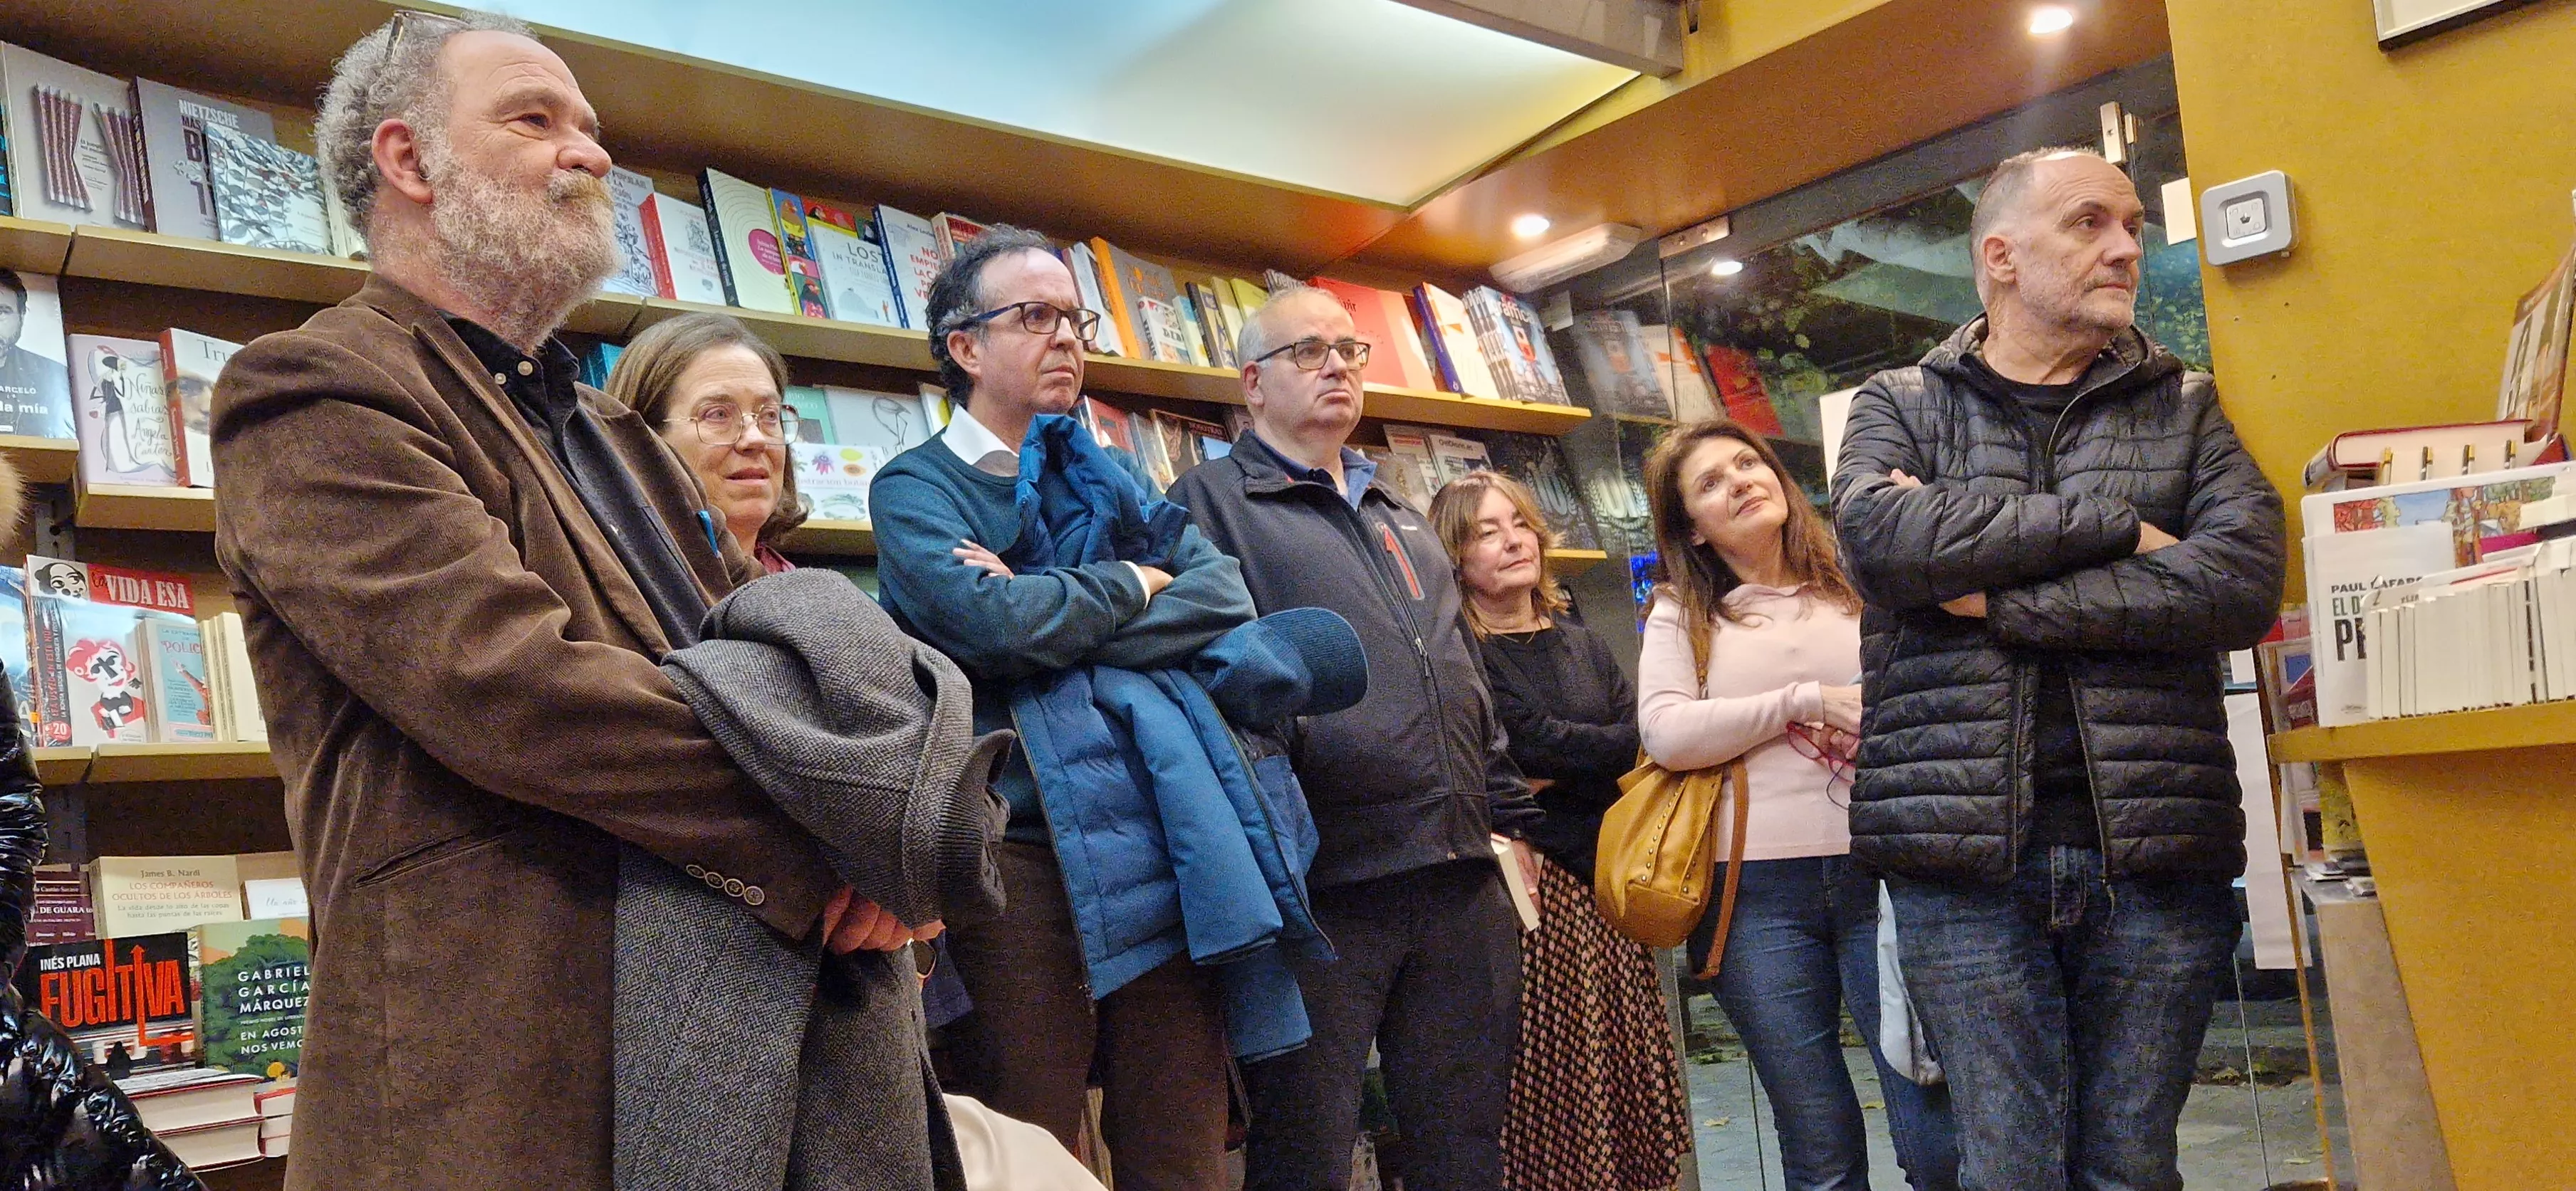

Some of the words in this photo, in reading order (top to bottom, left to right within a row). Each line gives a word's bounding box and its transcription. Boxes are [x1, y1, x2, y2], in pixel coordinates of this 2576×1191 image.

[178, 99, 240, 129] NIETZSCHE
[921, 246, 939, 261] NO
[846, 256, 888, 274] TRANSLA
[197, 339, 226, 362] Tru
[0, 385, 37, 394] ARCELO
[127, 373, 165, 400] Niñas
[19, 403, 48, 414] mía
[105, 574, 153, 604] VIDA
[155, 580, 189, 609] ESA
[2331, 582, 2367, 594] PAUL
[2332, 597, 2349, 617] EL
[160, 641, 202, 655] POLIC
[53, 723, 67, 735] 20
[150, 880, 214, 889] COMPAÑEROS
[112, 892, 157, 901] OCULTOS
[174, 891, 192, 900] LOS
[194, 890, 233, 899] ÁRBOLES
[40, 955, 65, 971] INÉS
[66, 953, 101, 967] PLANA
[238, 965, 311, 982] GABRIEL
[40, 951, 186, 1030] FUGITIVA
[238, 979, 310, 997] GARCÍA
[239, 996, 310, 1014] MÁRQUEZ
[241, 1031, 256, 1040] EN
[262, 1026, 303, 1039] AGOST
[241, 1043, 268, 1054] NOS
[271, 1039, 303, 1051] VEMO
